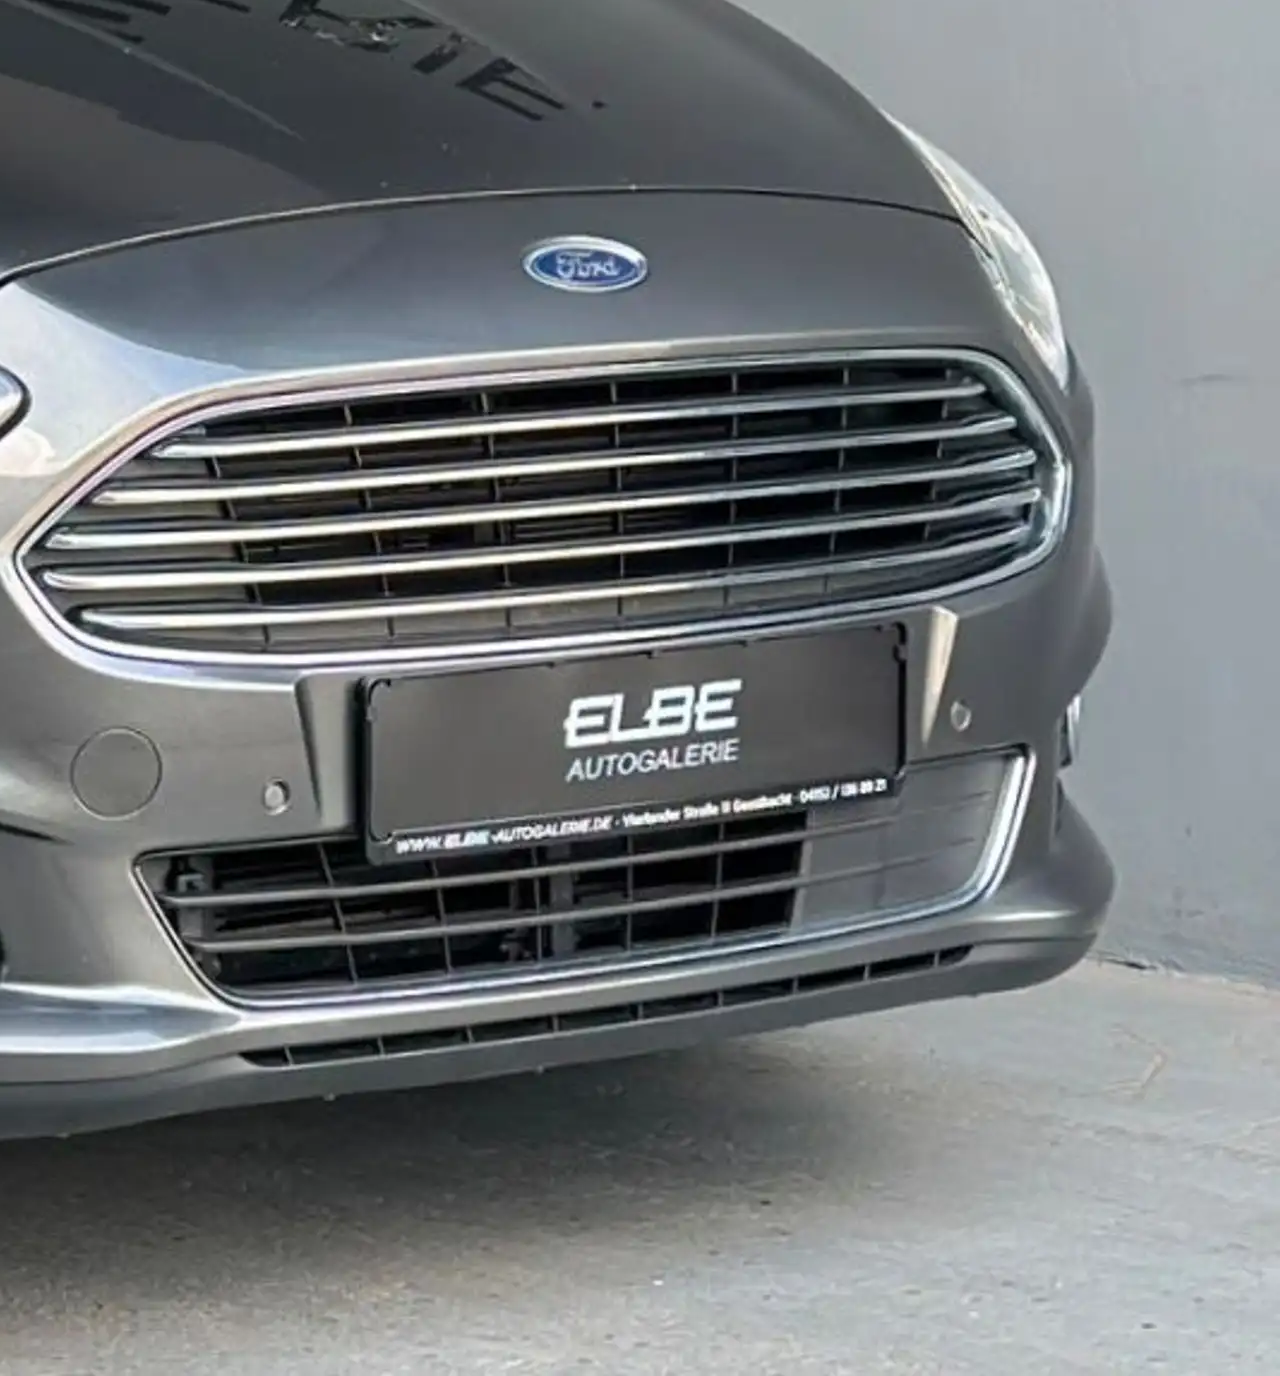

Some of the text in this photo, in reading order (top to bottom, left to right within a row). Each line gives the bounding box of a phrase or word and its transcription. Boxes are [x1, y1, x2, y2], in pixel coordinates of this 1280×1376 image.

[555, 250, 621, 281] Ford
[563, 678, 743, 749] ELBE
[565, 737, 740, 784] AUTOGALERIE
